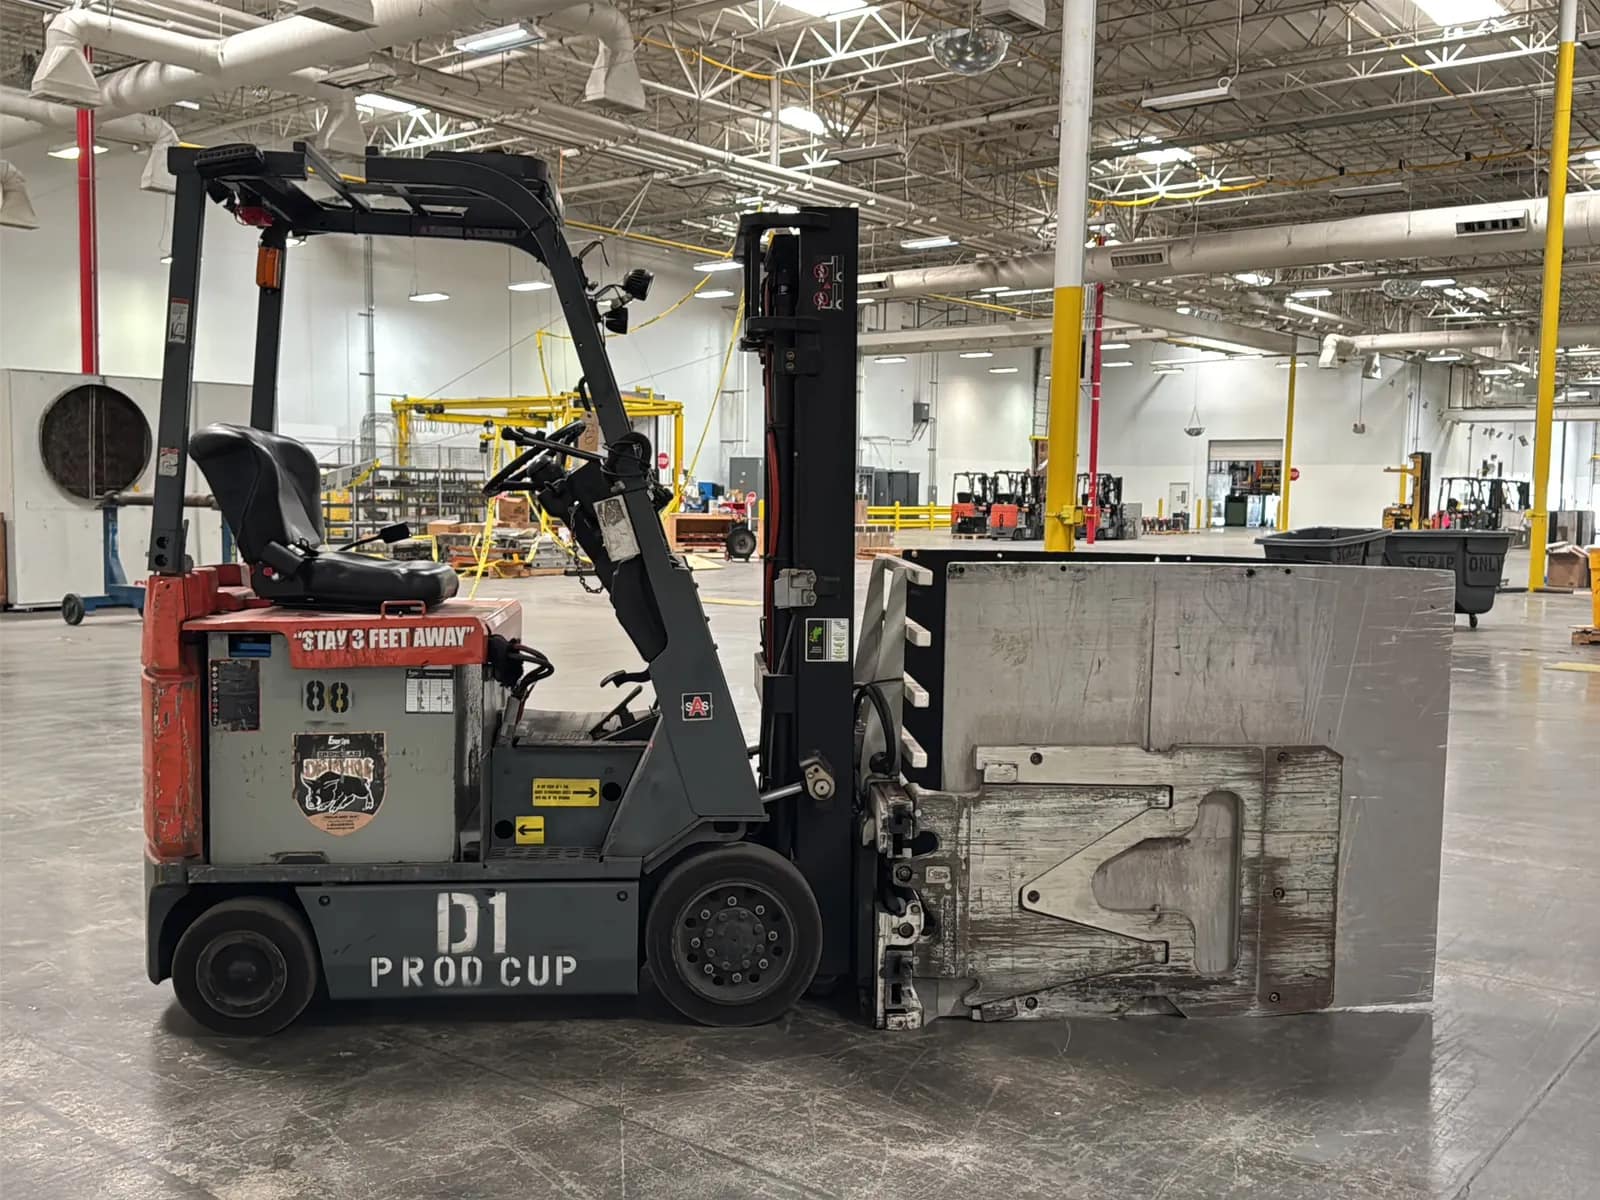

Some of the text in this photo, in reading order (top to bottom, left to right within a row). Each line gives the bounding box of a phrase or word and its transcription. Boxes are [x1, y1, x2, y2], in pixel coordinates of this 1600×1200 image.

[351, 629, 365, 649] 3
[369, 628, 409, 648] FEET
[306, 680, 349, 713] 88
[685, 696, 709, 716] SAS
[437, 892, 507, 953] D1
[370, 955, 577, 988] PROD CUP
